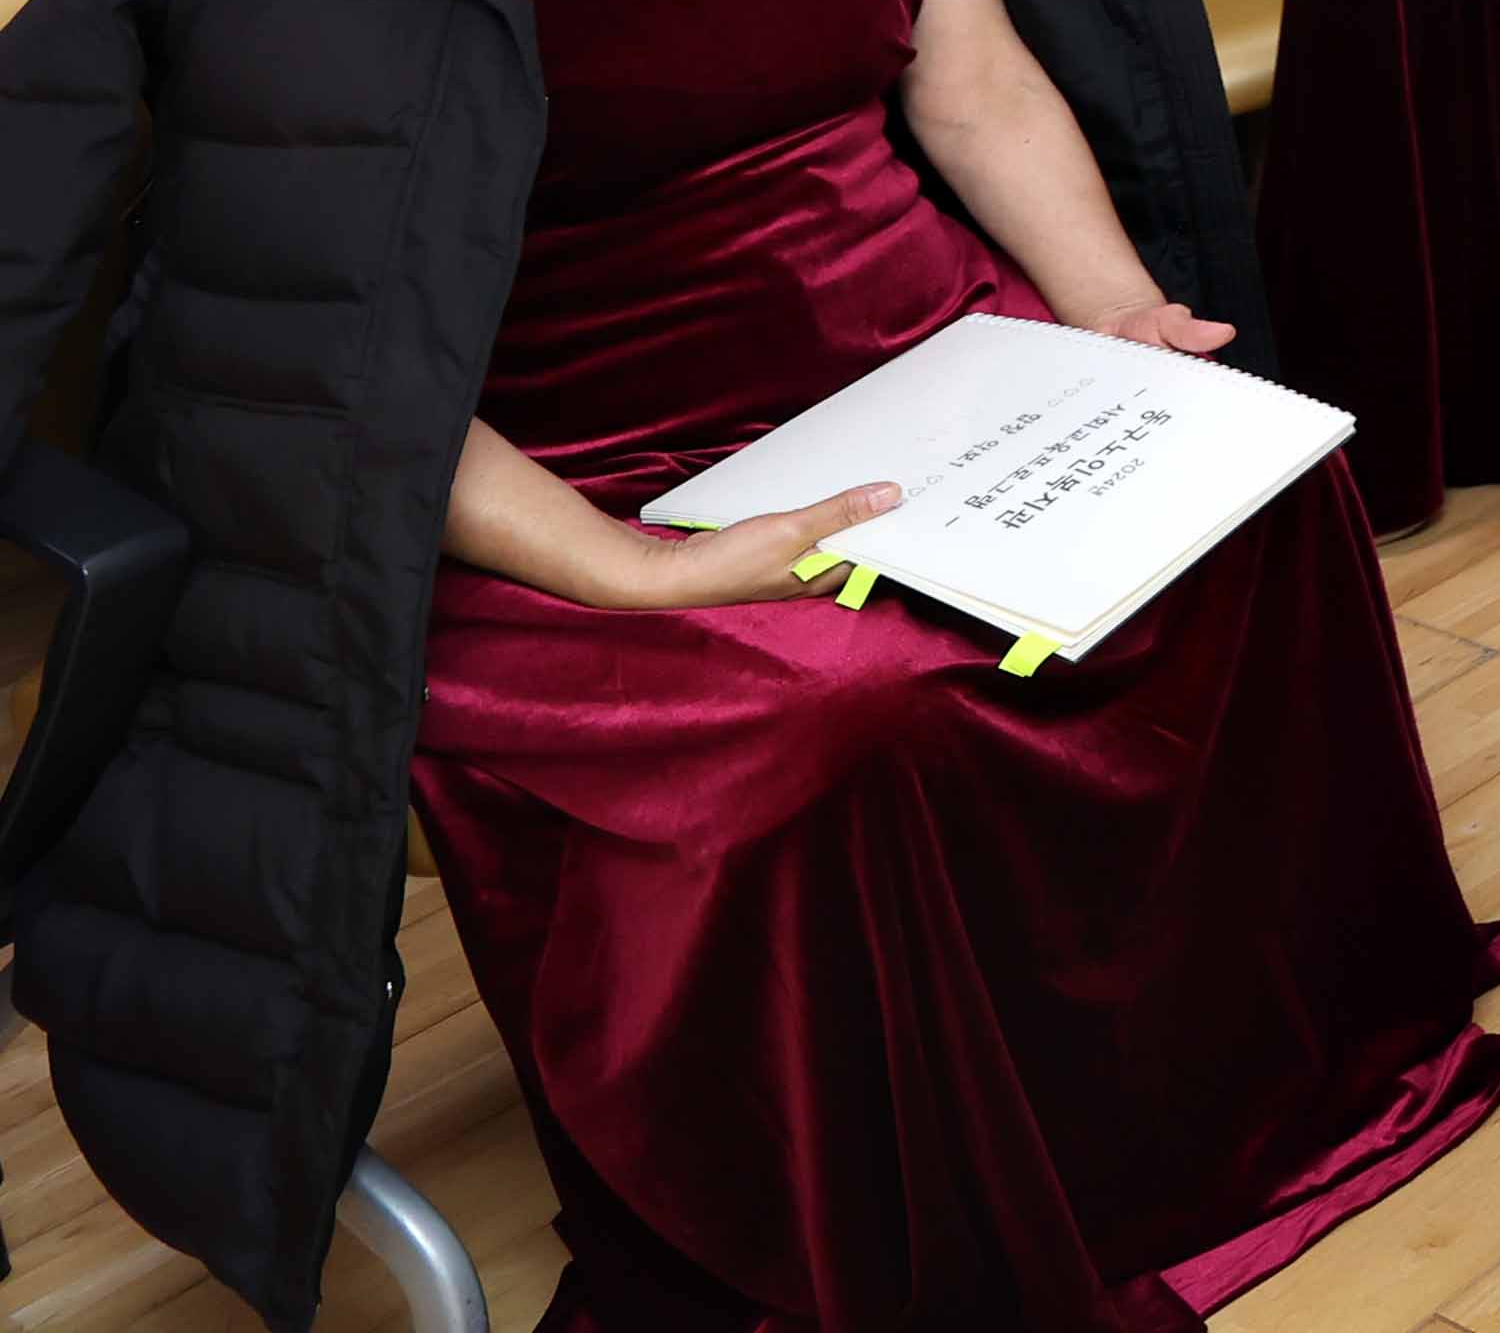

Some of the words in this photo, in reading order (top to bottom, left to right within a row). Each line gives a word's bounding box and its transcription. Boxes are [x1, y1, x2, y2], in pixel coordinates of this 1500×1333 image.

[963, 403, 1127, 510] 사회교육프로그램
[994, 408, 1173, 530] 동구노인복지관
[1088, 457, 1145, 498] 2024년
